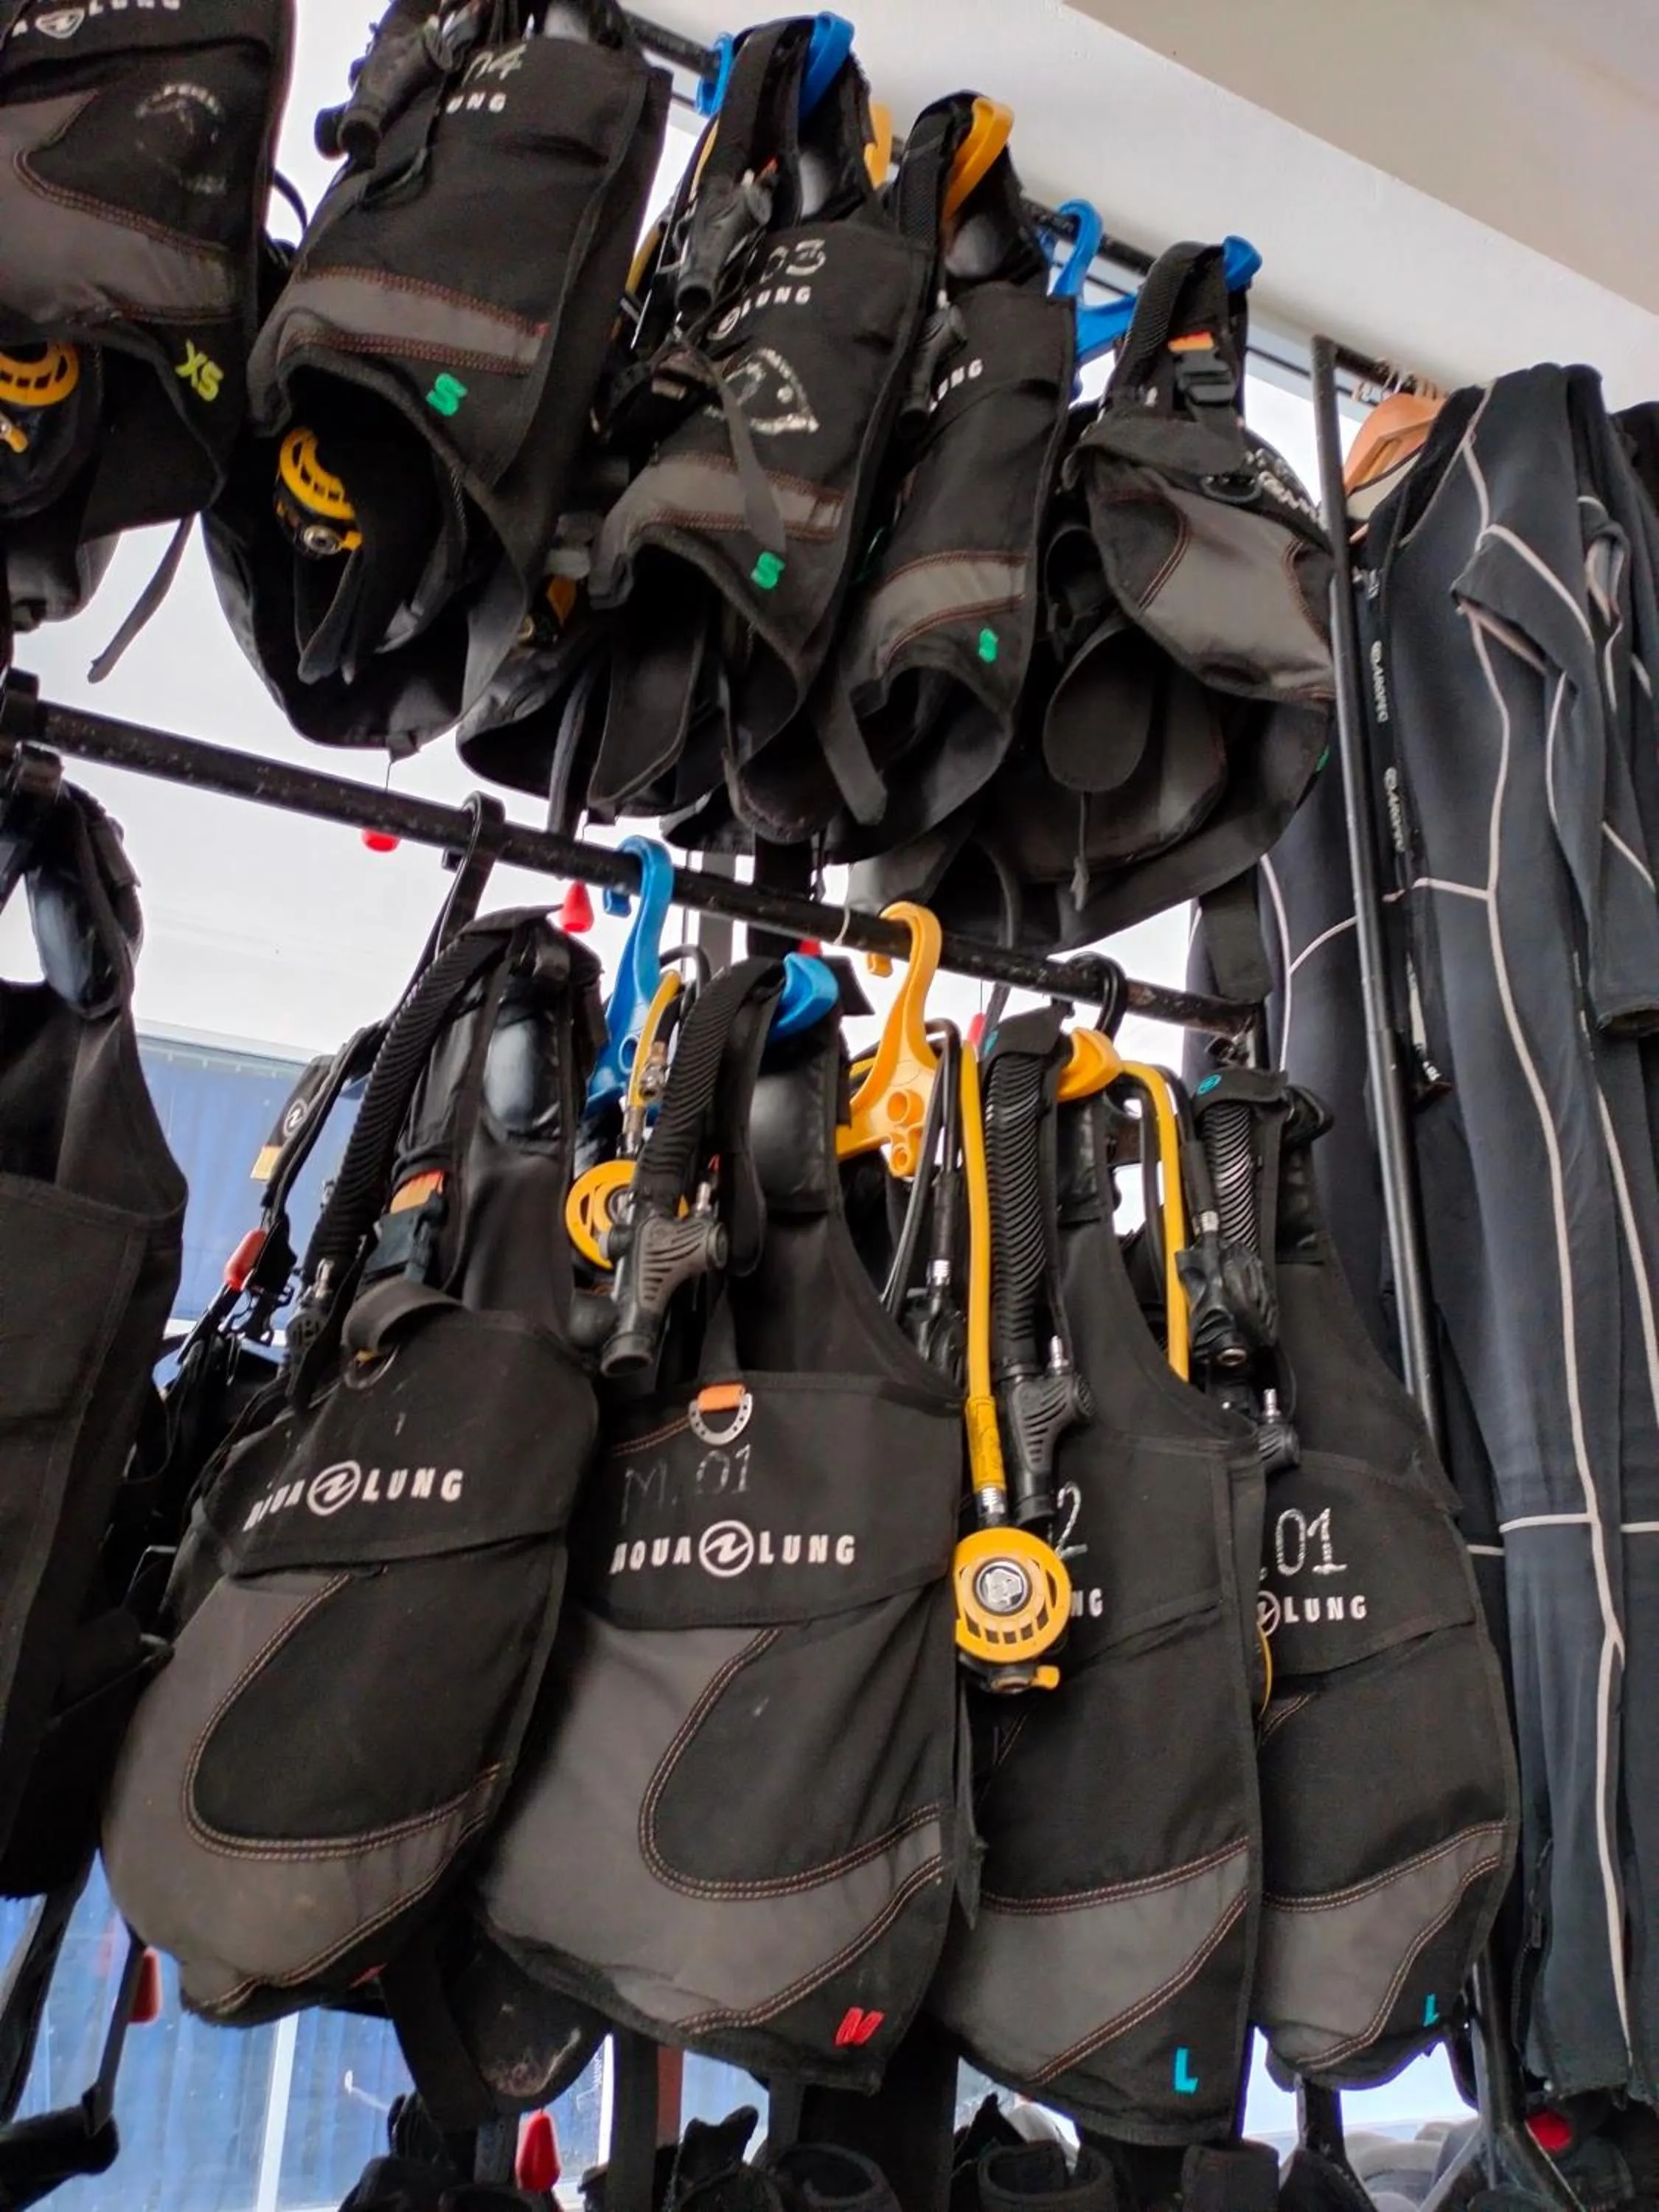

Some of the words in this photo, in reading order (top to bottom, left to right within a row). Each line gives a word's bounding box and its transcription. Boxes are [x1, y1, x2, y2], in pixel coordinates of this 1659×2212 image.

[445, 91, 507, 114] UNG
[174, 338, 224, 402] XS
[425, 372, 468, 416] S
[361, 1467, 464, 1501] LUNG
[608, 1536, 692, 1576] AQUA
[758, 1530, 855, 1565] LUNG
[1284, 1595, 1368, 1624] LUNG
[1422, 1993, 1440, 2028] L
[1175, 2047, 1199, 2094] L
